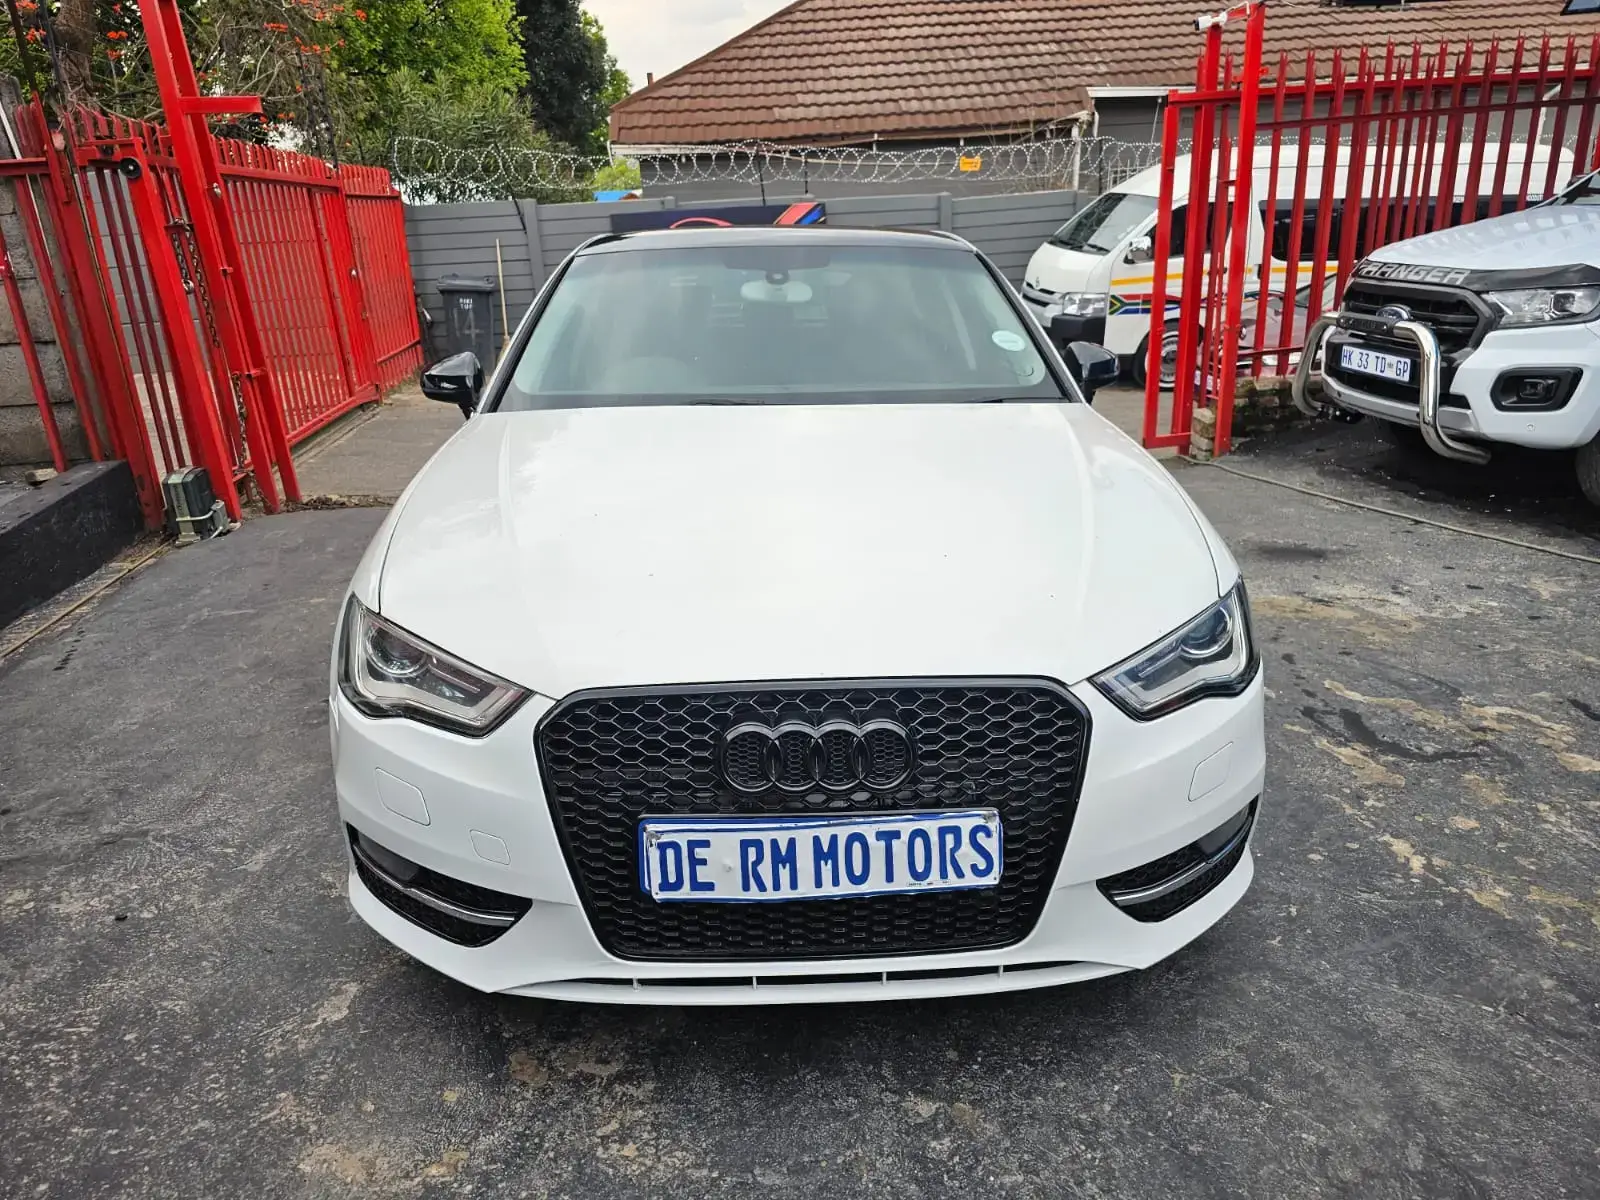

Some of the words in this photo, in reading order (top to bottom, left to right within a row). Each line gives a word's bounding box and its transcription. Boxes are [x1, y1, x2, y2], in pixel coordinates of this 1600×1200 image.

[1359, 261, 1472, 285] RANGER
[1342, 348, 1354, 366] HK
[1357, 351, 1370, 370] 33
[1375, 355, 1387, 374] TD
[1395, 360, 1409, 378] GP
[657, 839, 715, 892] DE
[739, 836, 798, 892] RM
[812, 823, 995, 889] MOTORS
